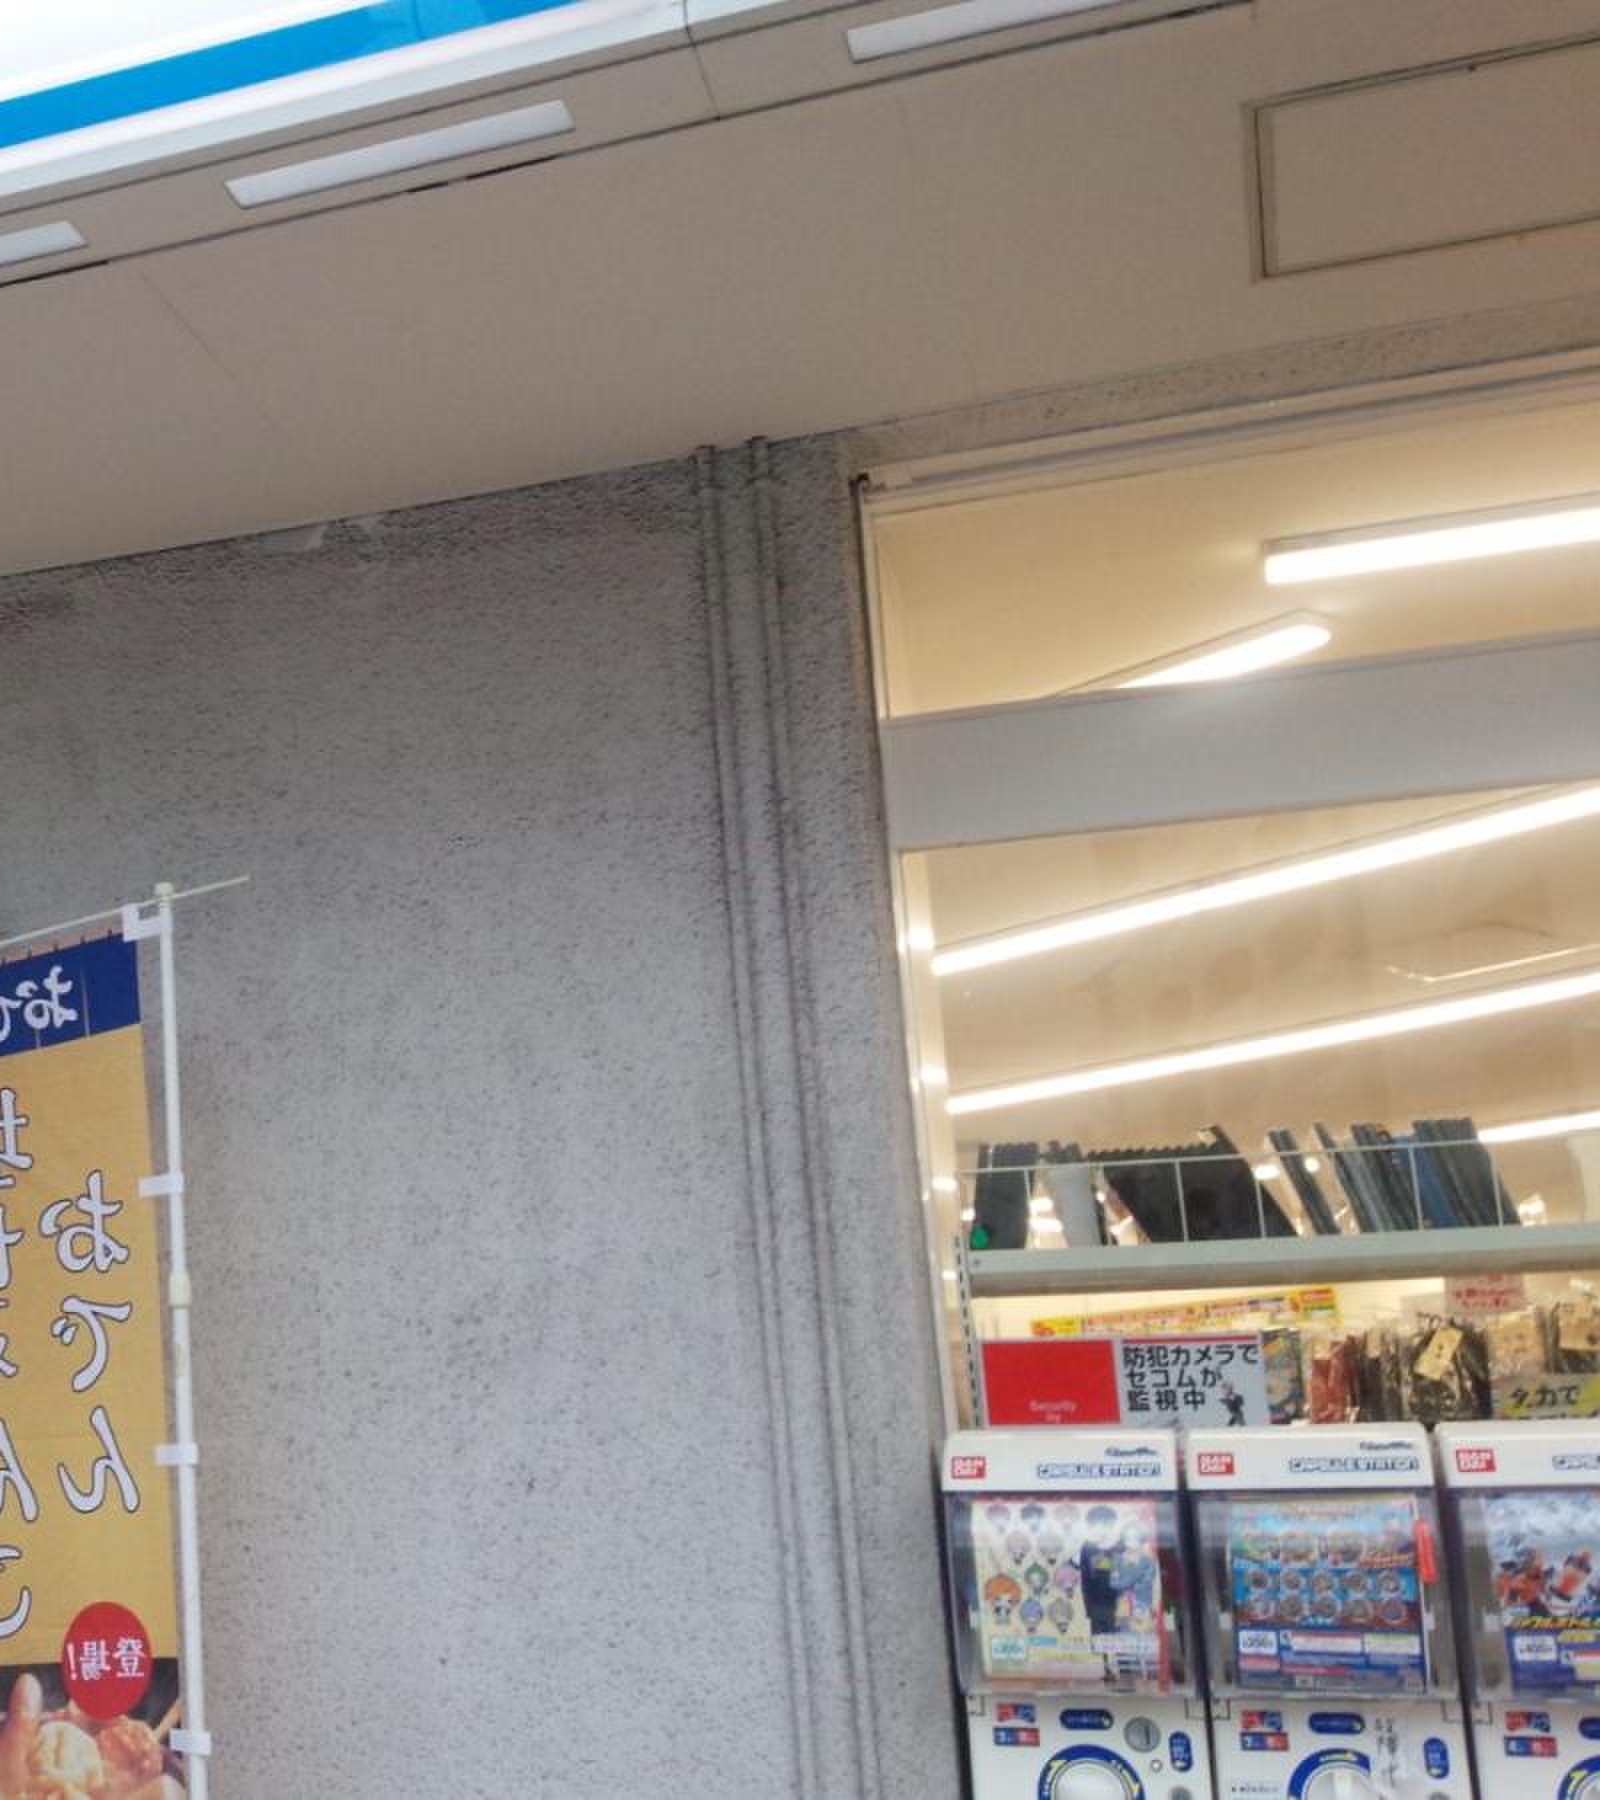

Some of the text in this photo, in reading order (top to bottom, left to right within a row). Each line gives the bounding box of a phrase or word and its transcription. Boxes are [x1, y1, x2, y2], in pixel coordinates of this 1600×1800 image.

[1122, 1343, 1260, 1369] 防犯カメラで
[1127, 1367, 1222, 1390] セコムが
[1127, 1389, 1206, 1412] 監視中
